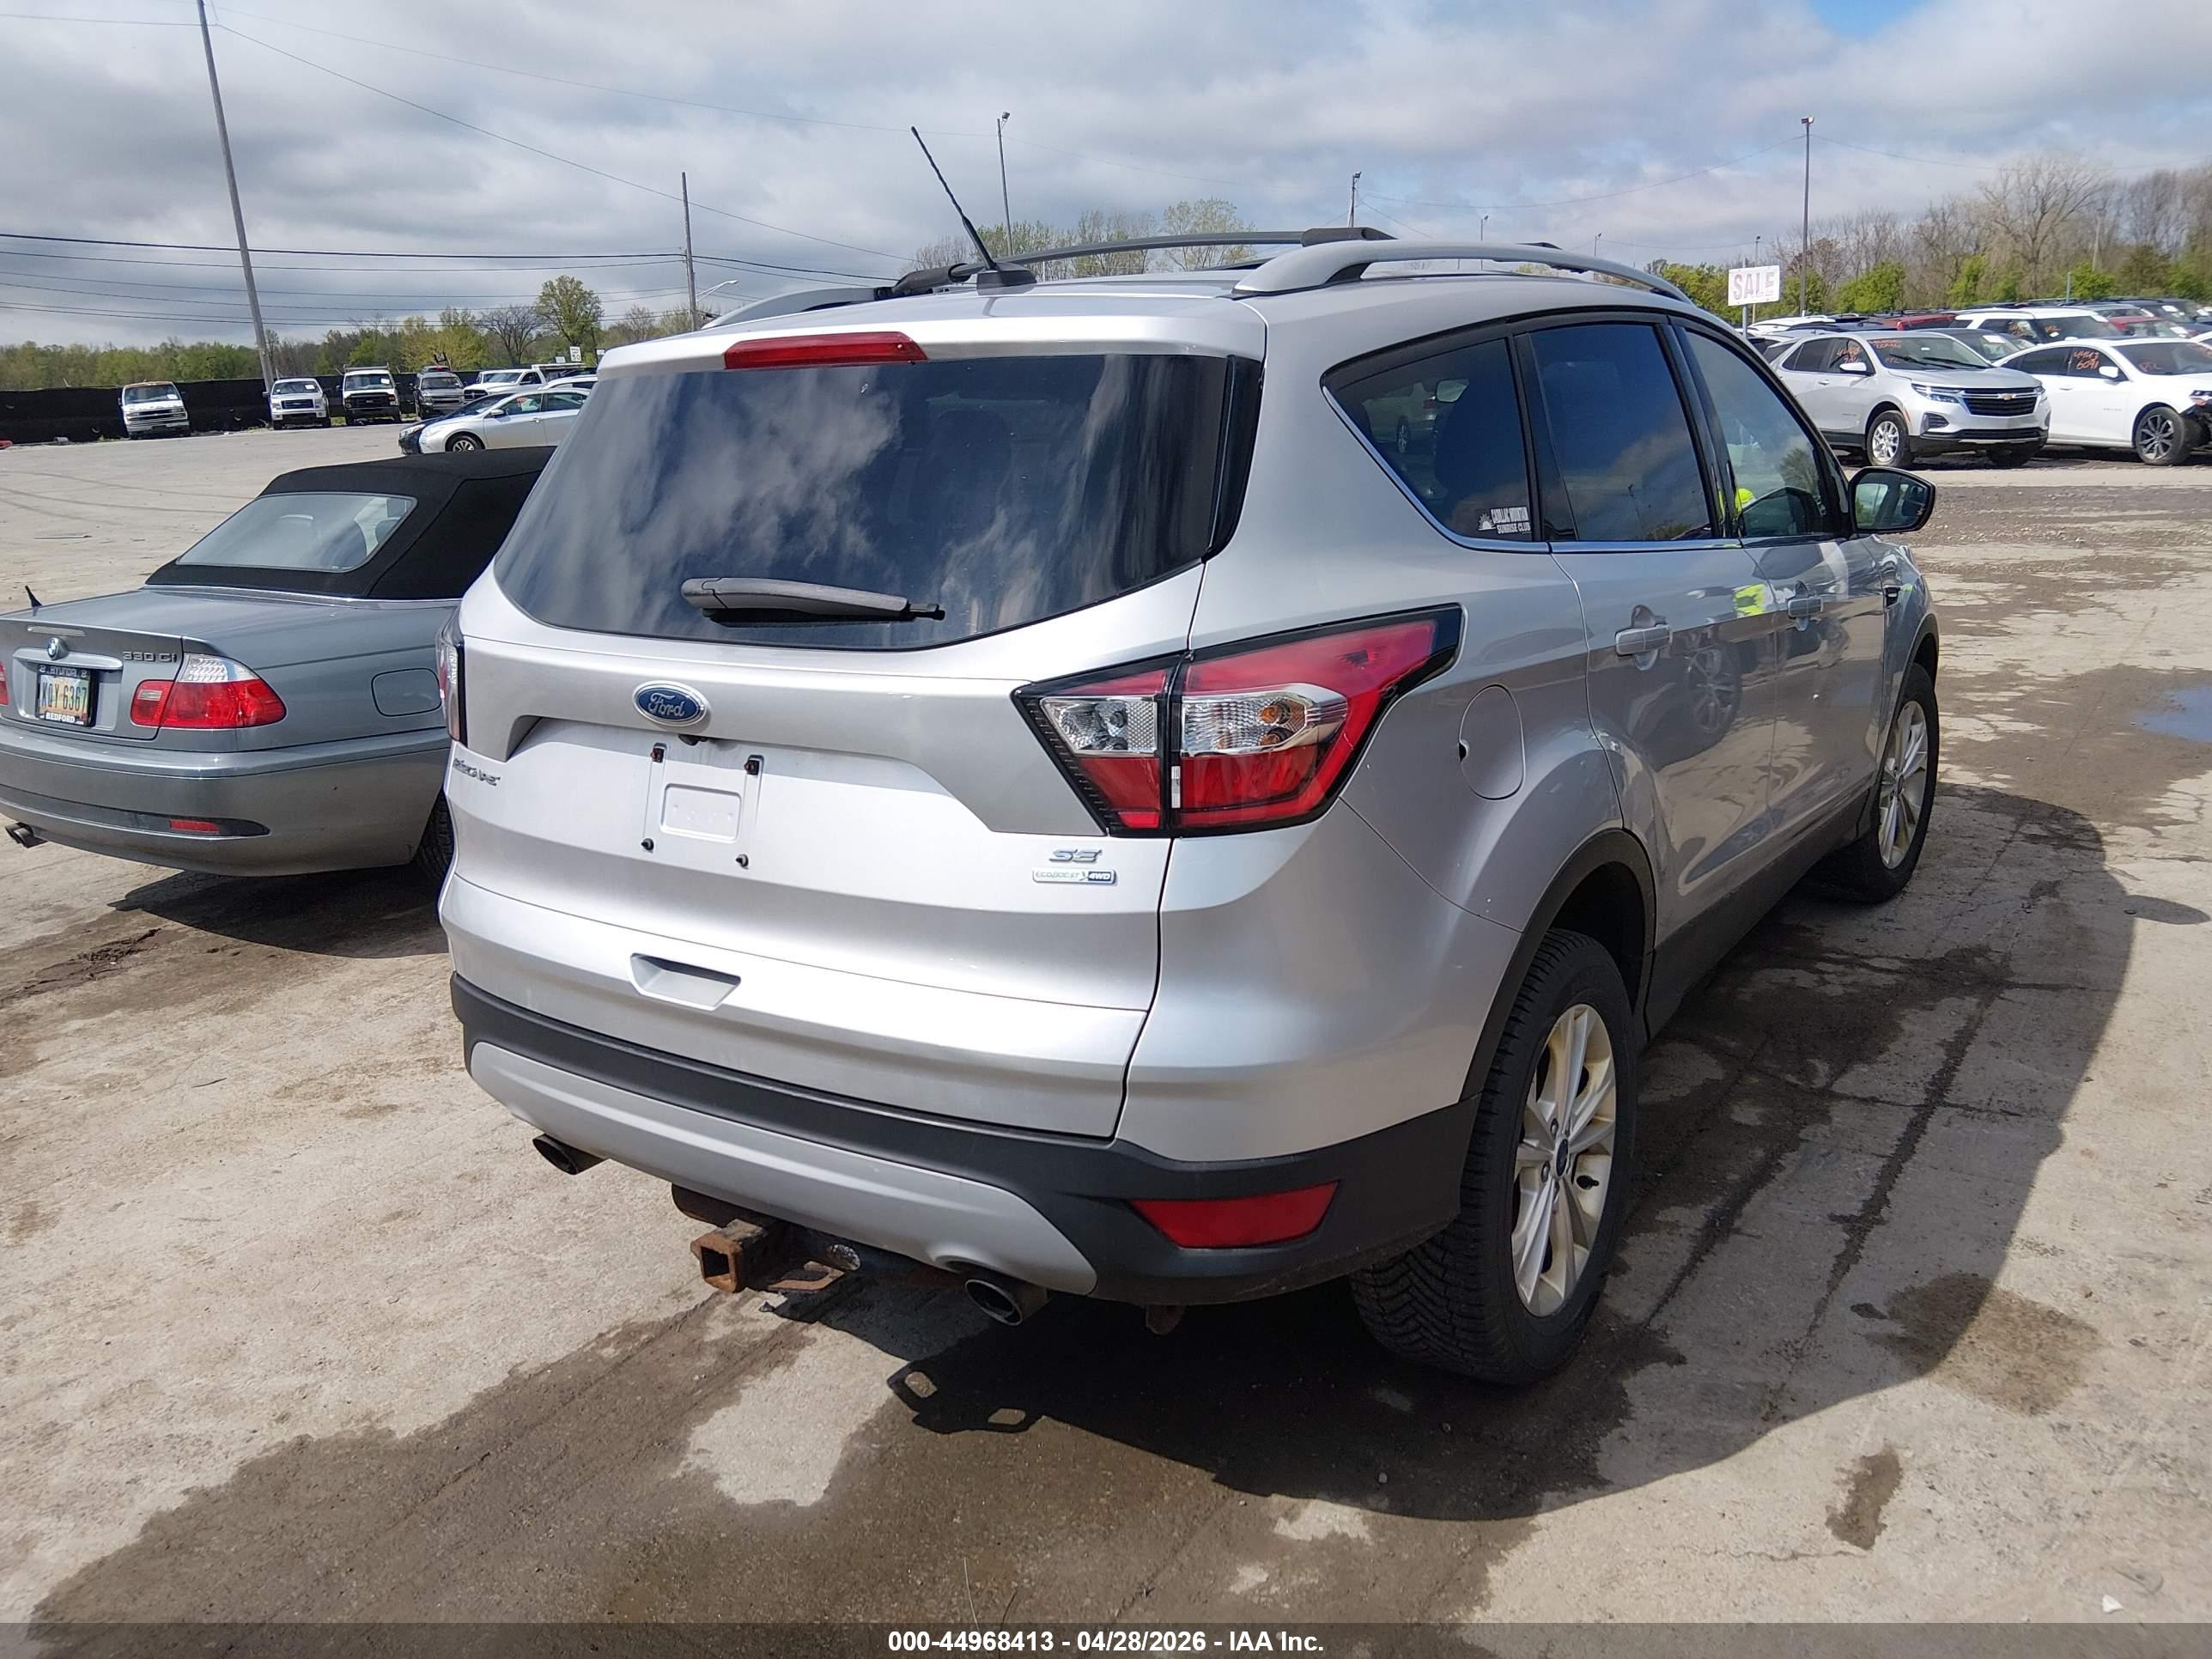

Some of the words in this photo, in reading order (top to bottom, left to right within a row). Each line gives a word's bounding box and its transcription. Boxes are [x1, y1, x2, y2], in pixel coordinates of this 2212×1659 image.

[1733, 271, 1774, 301] SALE
[123, 651, 155, 662] 330
[158, 652, 177, 664] Ci
[63, 684, 88, 712] 6367
[647, 692, 686, 717] Ford
[46, 712, 76, 723] BEDFORD
[1048, 848, 1103, 863] SE
[1088, 872, 1111, 881] 4WD
